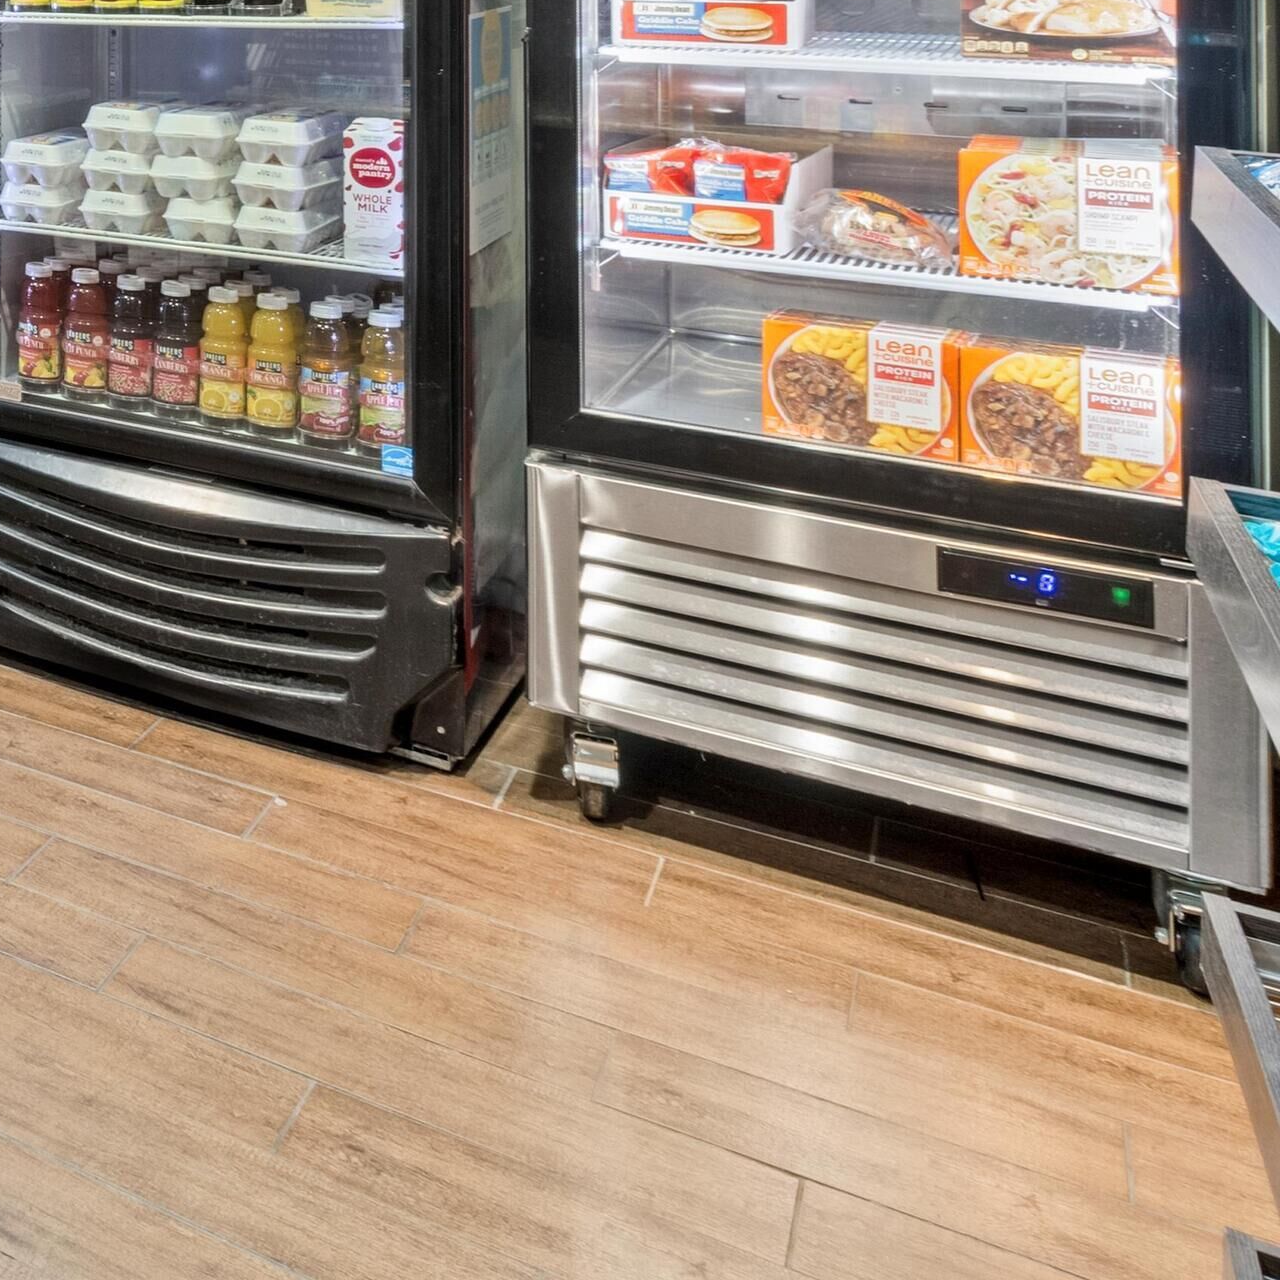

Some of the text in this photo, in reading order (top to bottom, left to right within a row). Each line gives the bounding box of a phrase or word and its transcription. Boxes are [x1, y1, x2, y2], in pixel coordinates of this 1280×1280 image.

[352, 162, 391, 172] modern
[358, 169, 393, 180] pantry
[1086, 163, 1151, 180] Lean
[352, 192, 392, 206] WHOLE
[1086, 190, 1152, 204] PROTEIN
[357, 202, 389, 214] MILK
[875, 339, 933, 358] Lean
[876, 365, 933, 381] PROTEIN
[1088, 367, 1154, 387] Lean
[1090, 394, 1154, 411] PROTEIN
